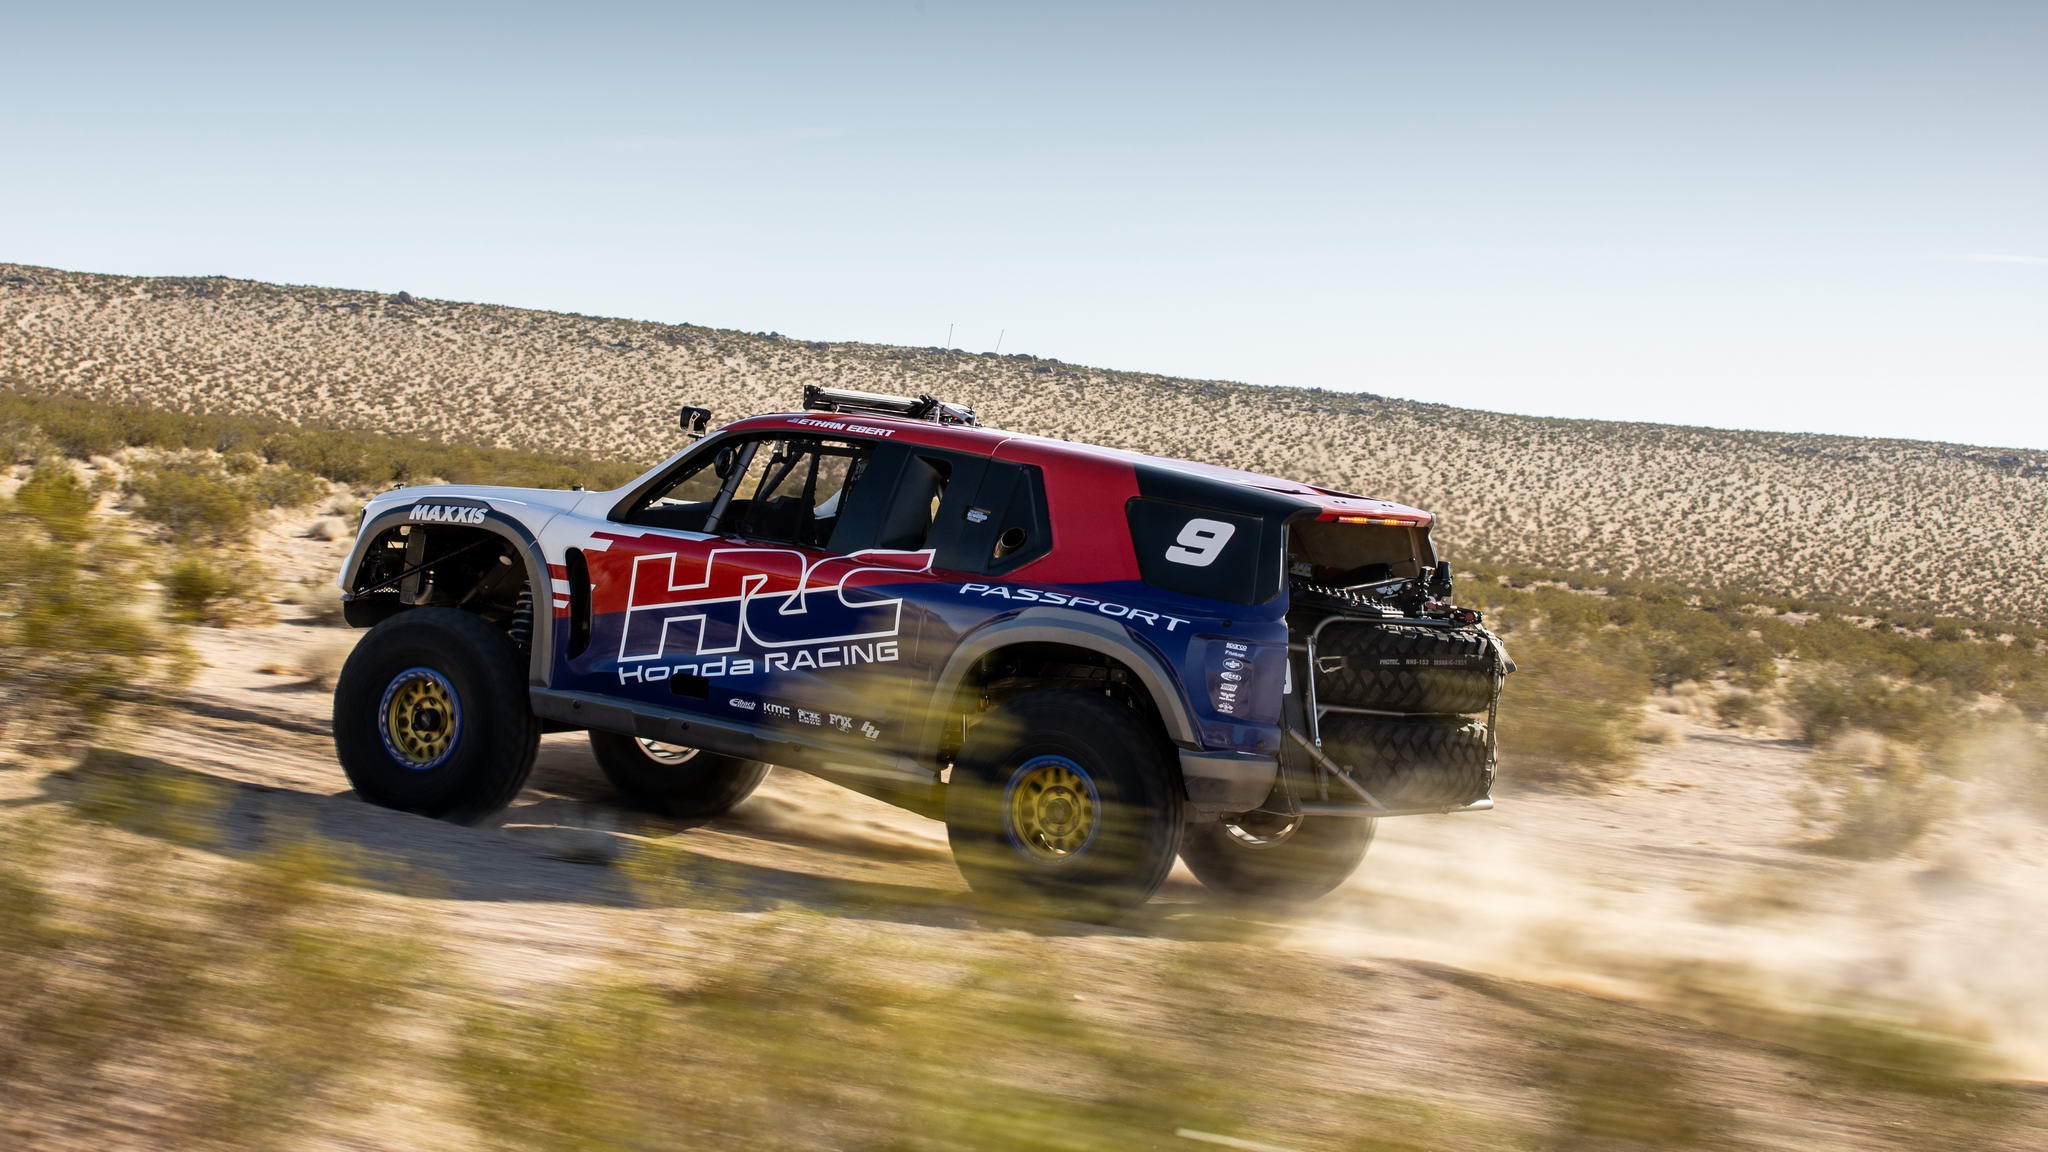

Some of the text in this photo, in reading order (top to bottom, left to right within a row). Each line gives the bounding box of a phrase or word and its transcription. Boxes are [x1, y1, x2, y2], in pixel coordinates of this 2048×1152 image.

[798, 419, 895, 436] ETHAN EBERT
[408, 504, 489, 524] MAXXIS
[1164, 517, 1236, 567] 9
[617, 548, 937, 663] HRC
[958, 582, 1191, 632] PASSPORT
[617, 640, 899, 685] Honda RACING
[763, 703, 790, 716] KMC
[829, 714, 852, 730] FOX
